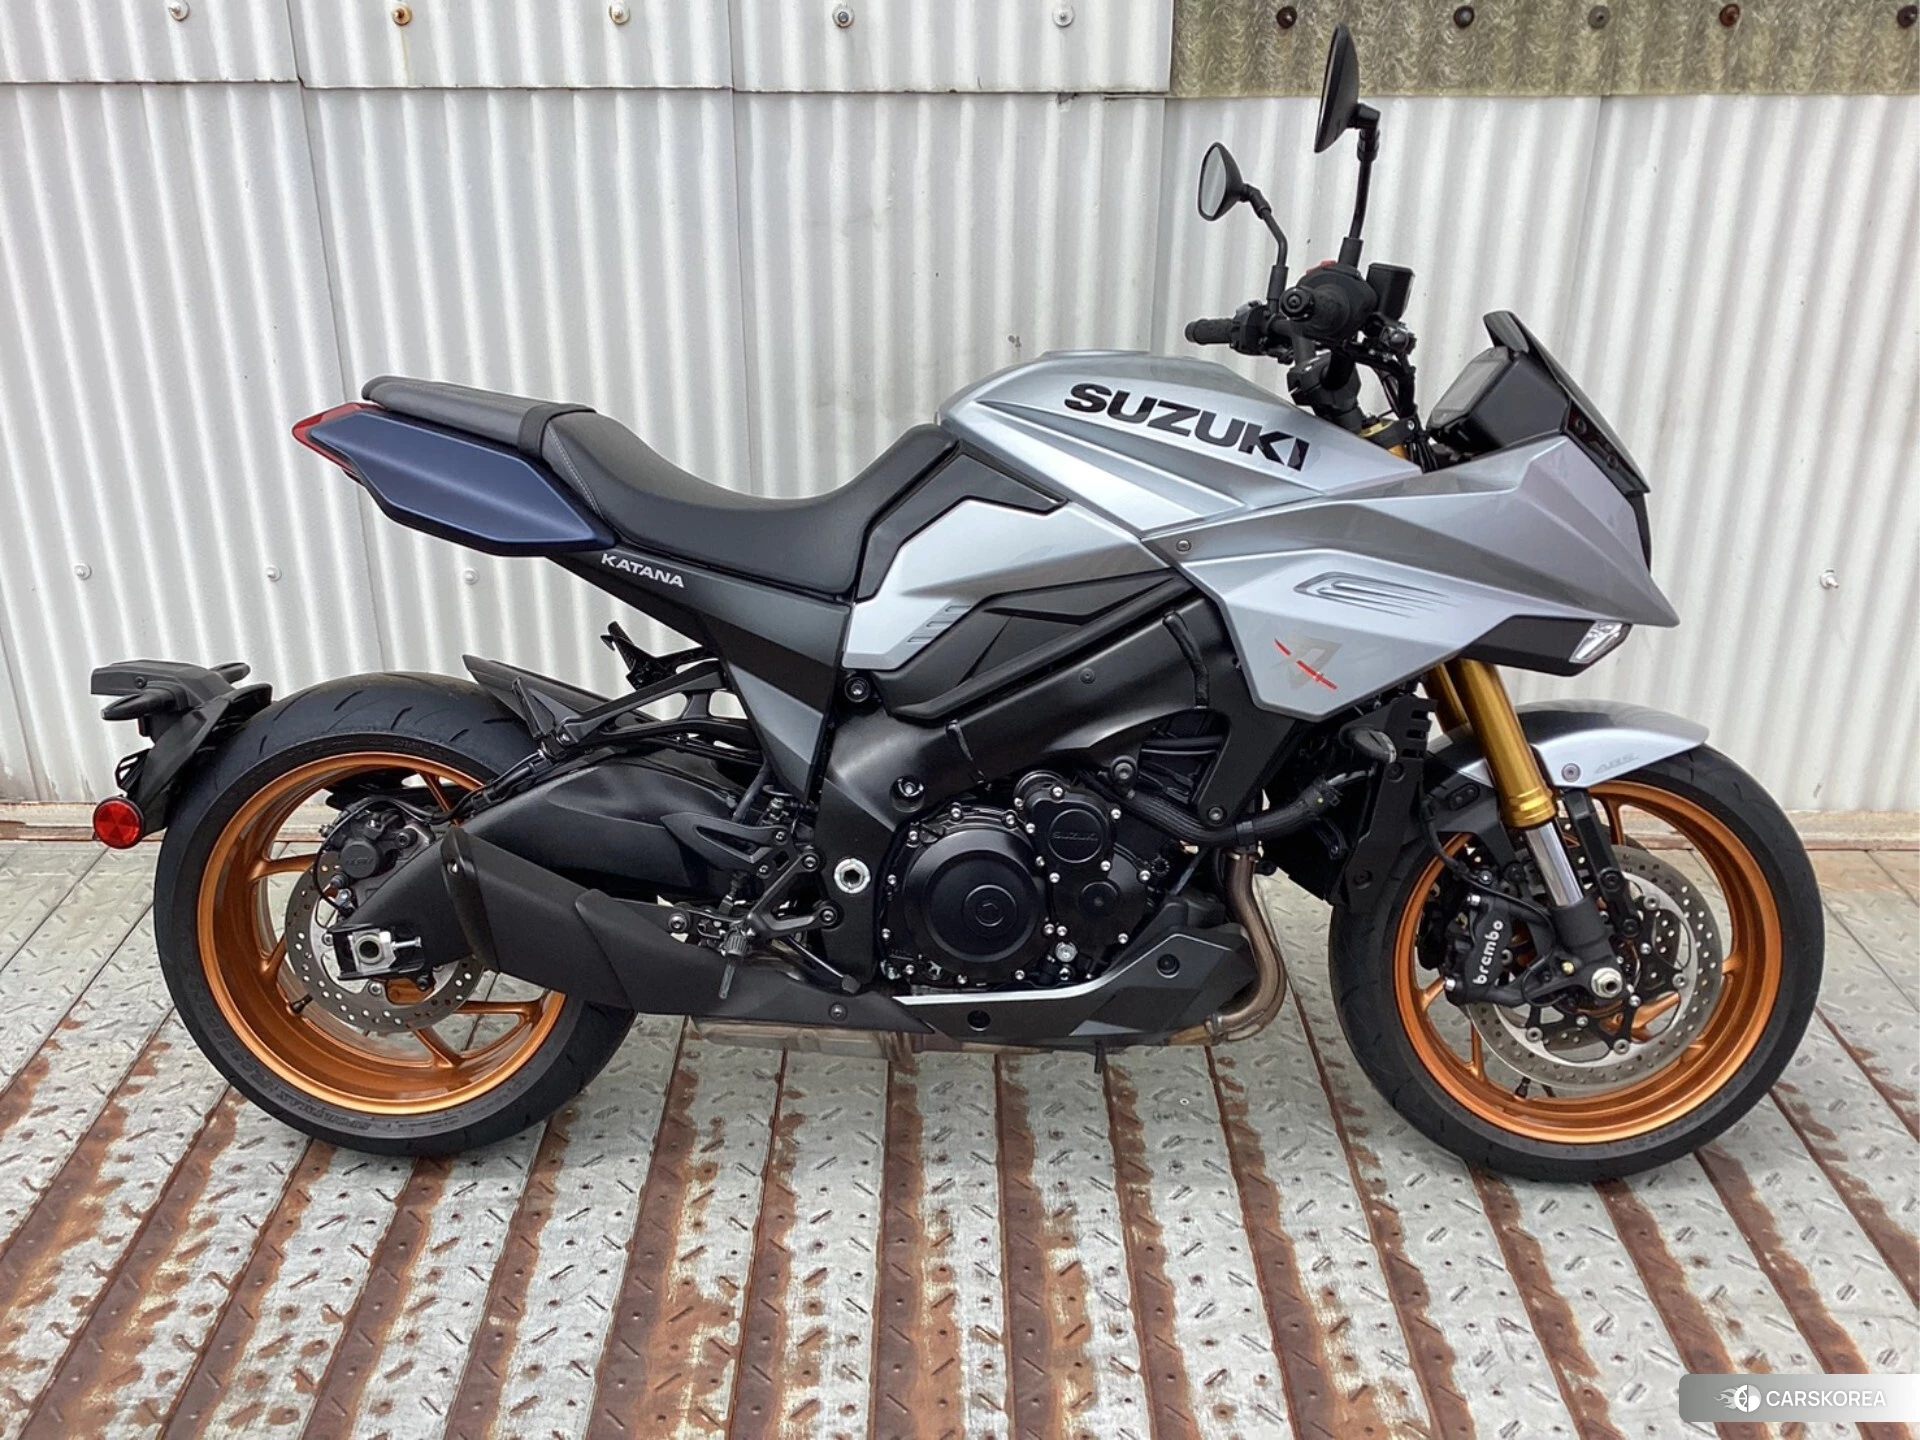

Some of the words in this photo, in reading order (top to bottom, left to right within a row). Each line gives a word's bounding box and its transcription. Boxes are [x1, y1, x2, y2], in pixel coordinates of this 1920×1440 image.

[1064, 383, 1310, 472] SUZUKI
[601, 553, 684, 588] KATANA
[1472, 920, 1504, 985] brembo
